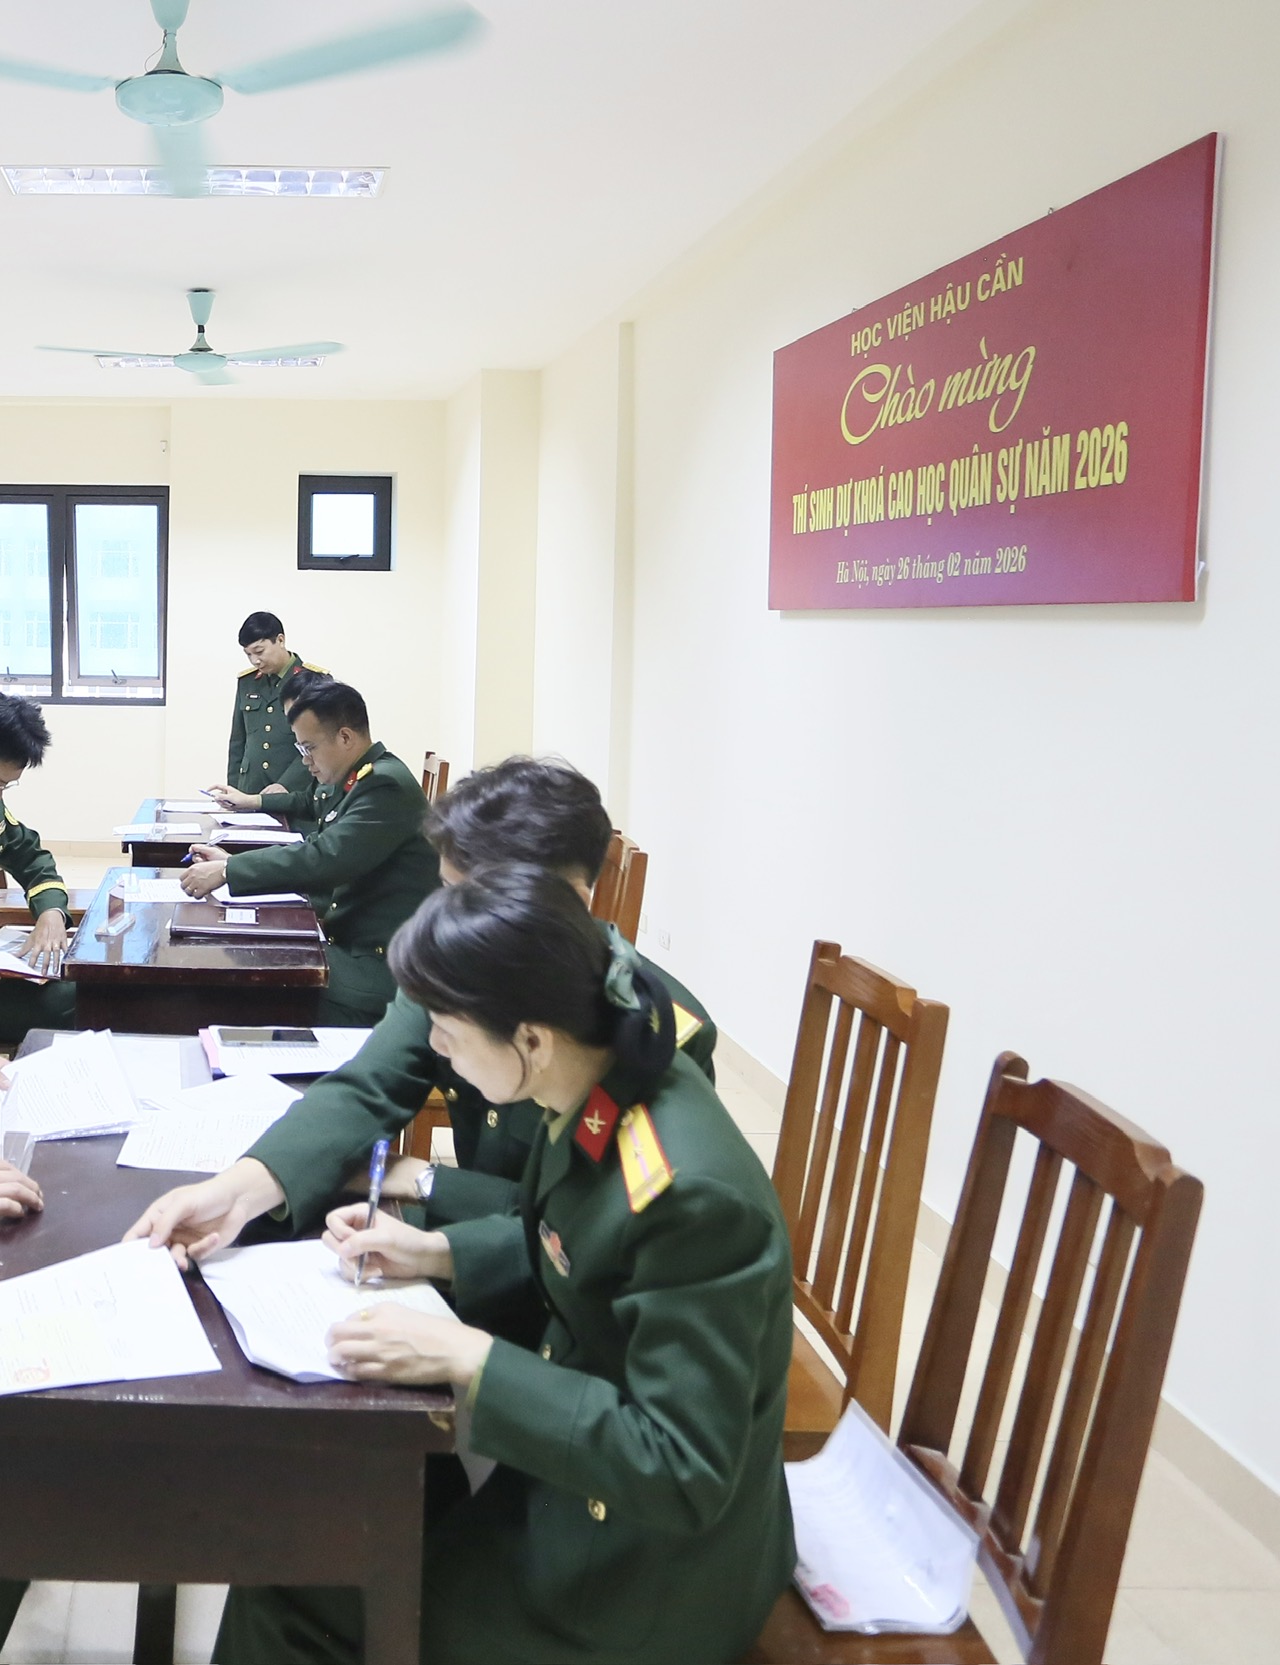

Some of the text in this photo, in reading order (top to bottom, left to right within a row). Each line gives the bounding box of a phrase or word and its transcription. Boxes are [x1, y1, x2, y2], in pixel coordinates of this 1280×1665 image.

[851, 253, 1024, 358] HỌC VIỆN HẬU CẦN
[840, 336, 1036, 445] Chào mừng
[792, 421, 1129, 537] THÍ SINH DỰ KHOÁ CAO HỌC QUÂN SỰ NĂM 2026
[836, 561, 849, 584] Hà
[872, 558, 896, 587] ngày
[897, 556, 910, 580] 26
[912, 555, 945, 584] tháng
[947, 552, 961, 577] 02
[963, 551, 992, 576] năm
[994, 545, 1027, 574] 2026
